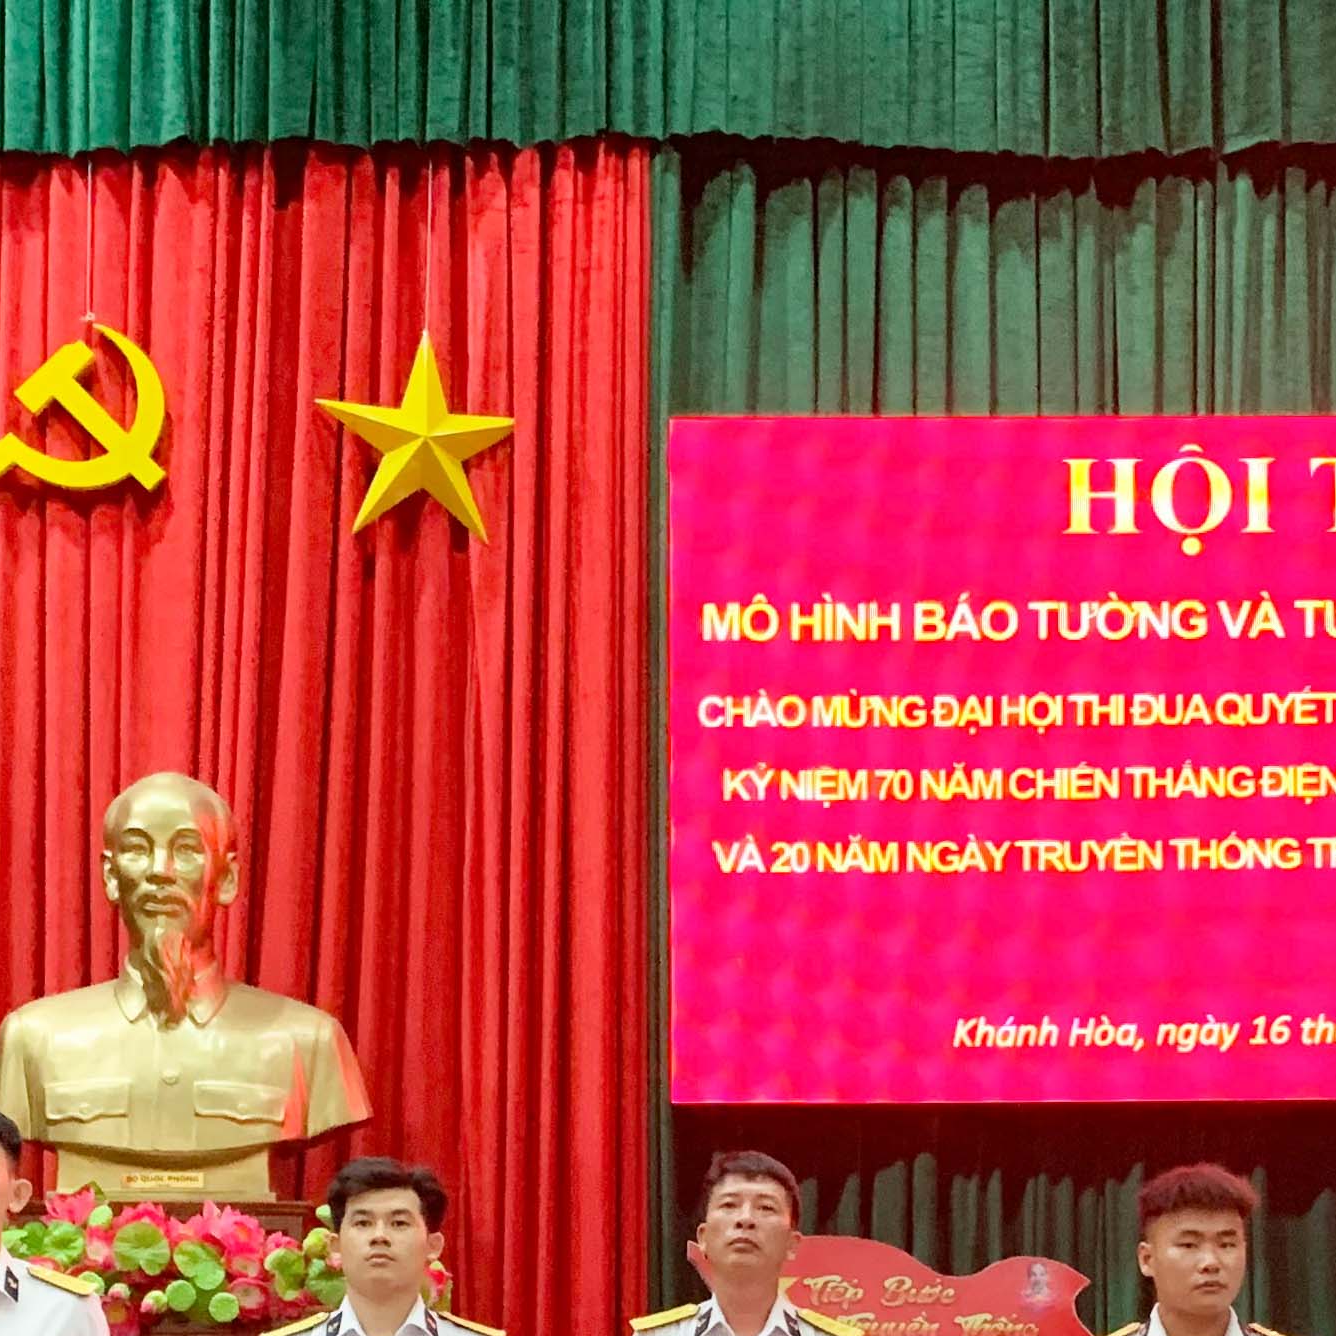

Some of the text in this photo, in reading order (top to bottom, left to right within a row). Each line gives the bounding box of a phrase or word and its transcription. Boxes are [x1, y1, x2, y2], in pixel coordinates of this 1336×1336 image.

[1062, 443, 1275, 556] HỘI
[701, 592, 780, 642] MÔ
[789, 592, 902, 642] HÌNH
[913, 591, 1018, 642] BÁO
[1028, 591, 1208, 641] TƯỜNG
[1217, 591, 1286, 640] VÀ
[697, 690, 806, 728] CHÀO
[811, 689, 927, 728] MỪNG
[931, 694, 995, 735] ĐẠI
[1000, 692, 1065, 735] HỘI
[1069, 693, 1125, 726] THI
[1130, 693, 1212, 726] ĐUA
[721, 762, 777, 801] KỶ
[779, 767, 868, 808] NIỆM
[874, 769, 913, 801] 70
[920, 762, 1003, 801] NĂM
[1007, 760, 1119, 800] CHIẾN
[1125, 759, 1256, 799] THẮNG
[712, 834, 772, 873] VÀ
[771, 841, 810, 873] 20
[815, 834, 900, 873] NĂM
[906, 834, 1011, 873] NGÀY
[1014, 831, 1163, 872] TRUYỀN
[1169, 830, 1301, 871] THỐNG
[952, 1017, 1059, 1048] Khánh
[1068, 1016, 1145, 1051] Hòa,
[1155, 1016, 1240, 1053] ngày
[1249, 1015, 1292, 1045] 16
